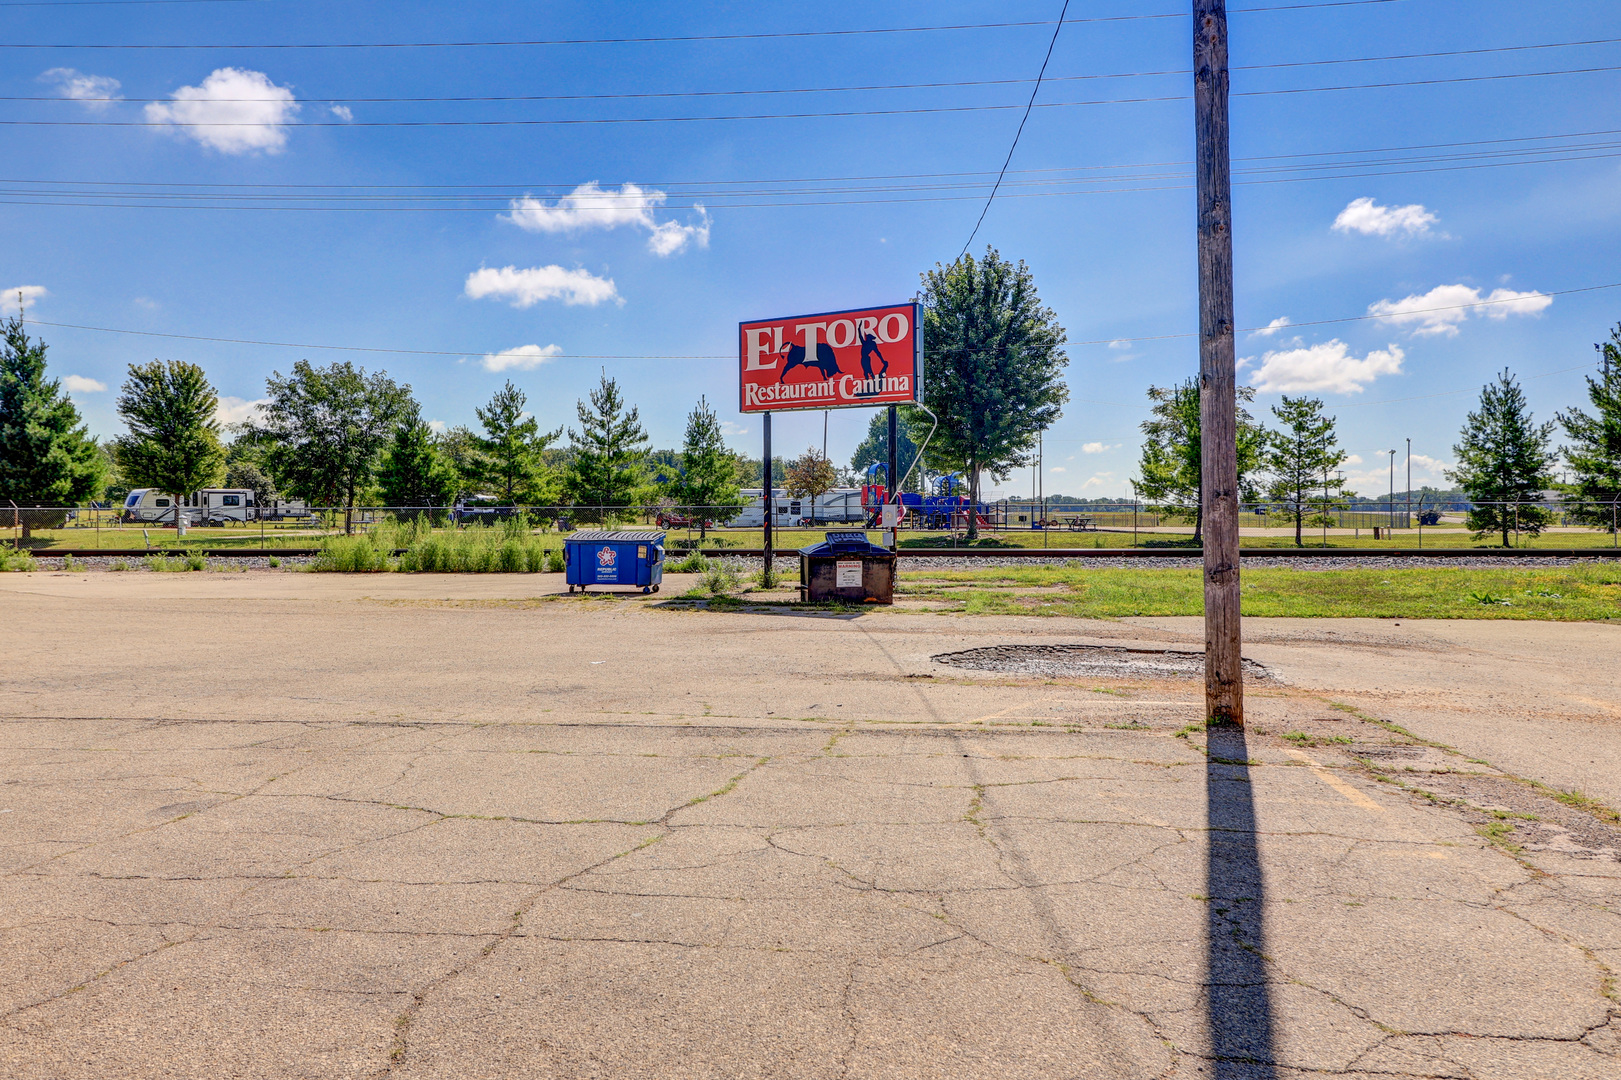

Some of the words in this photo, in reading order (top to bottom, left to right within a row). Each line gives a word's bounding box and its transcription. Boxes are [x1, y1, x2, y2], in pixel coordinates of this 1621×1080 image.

[795, 313, 909, 363] TORO
[745, 378, 836, 405] Restaurant
[838, 372, 909, 399] Cantina
